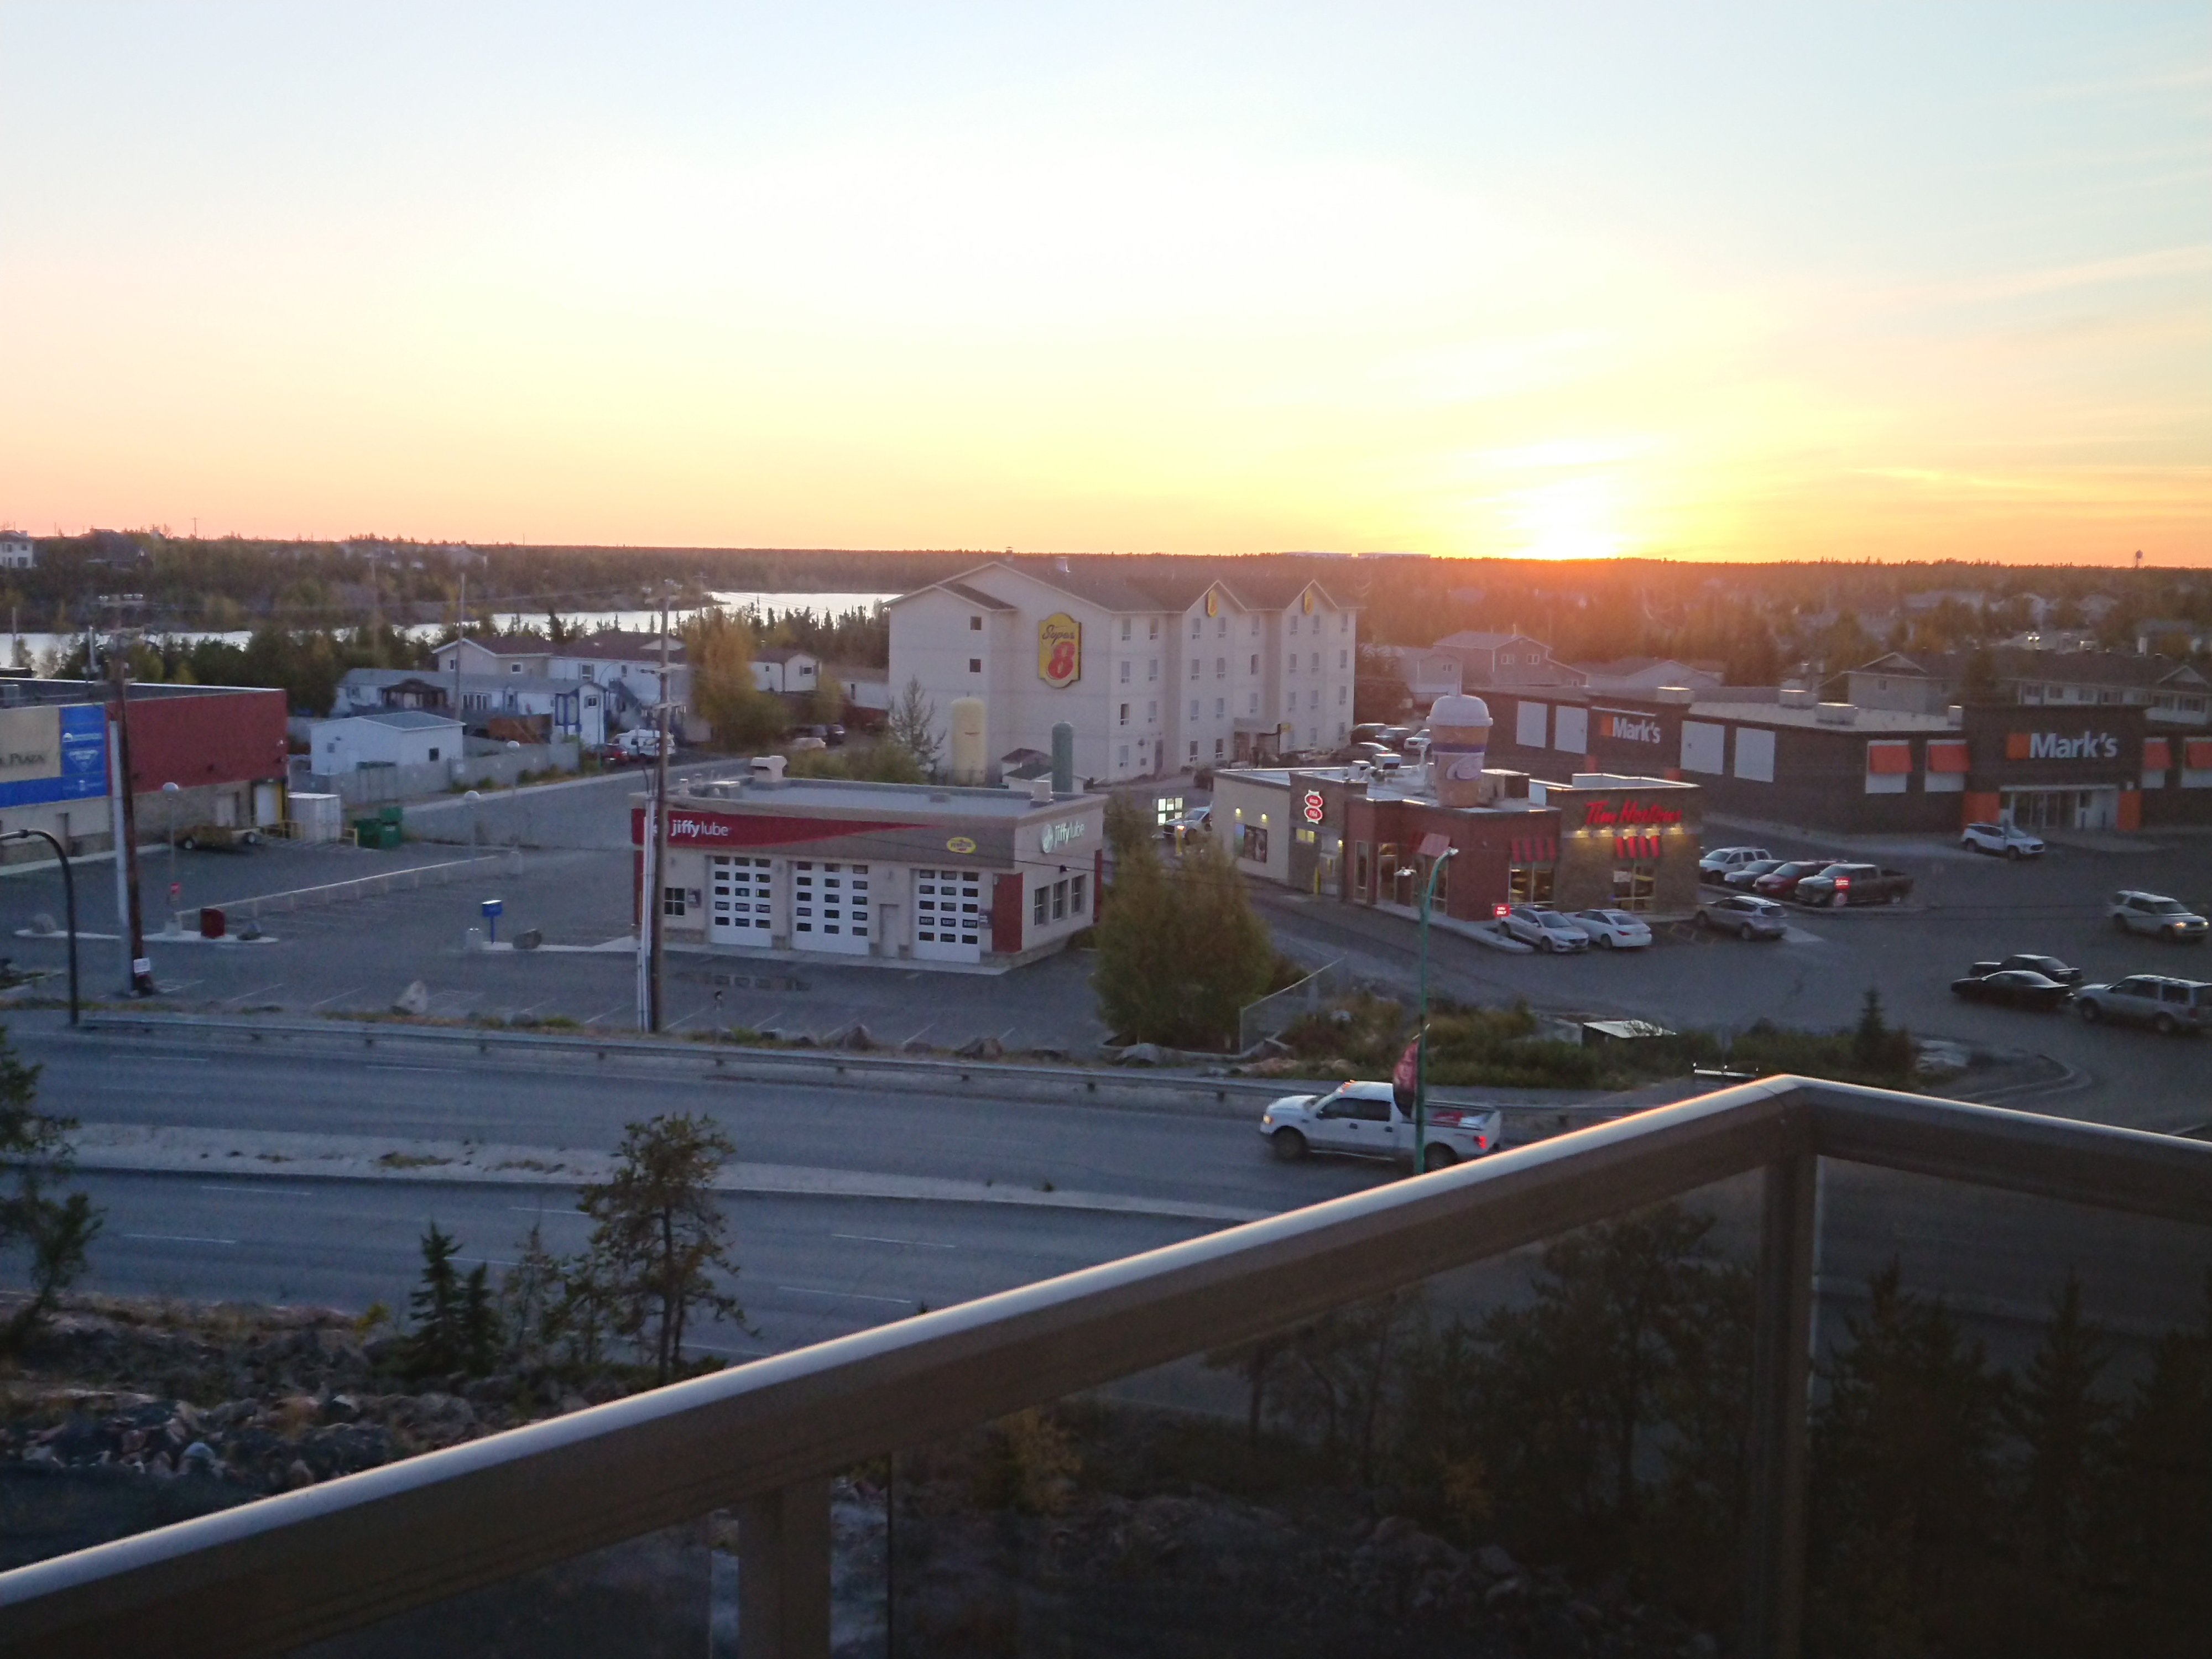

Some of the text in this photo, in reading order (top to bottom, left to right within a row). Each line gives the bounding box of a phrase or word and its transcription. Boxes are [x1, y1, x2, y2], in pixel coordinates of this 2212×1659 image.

[1042, 624, 1076, 646] Super
[1047, 641, 1076, 680] 8
[1613, 716, 1661, 744] Mark's
[2029, 731, 2117, 758] Mark's
[1585, 799, 1682, 826] Tim Hortons
[671, 820, 729, 837] jiffy lube
